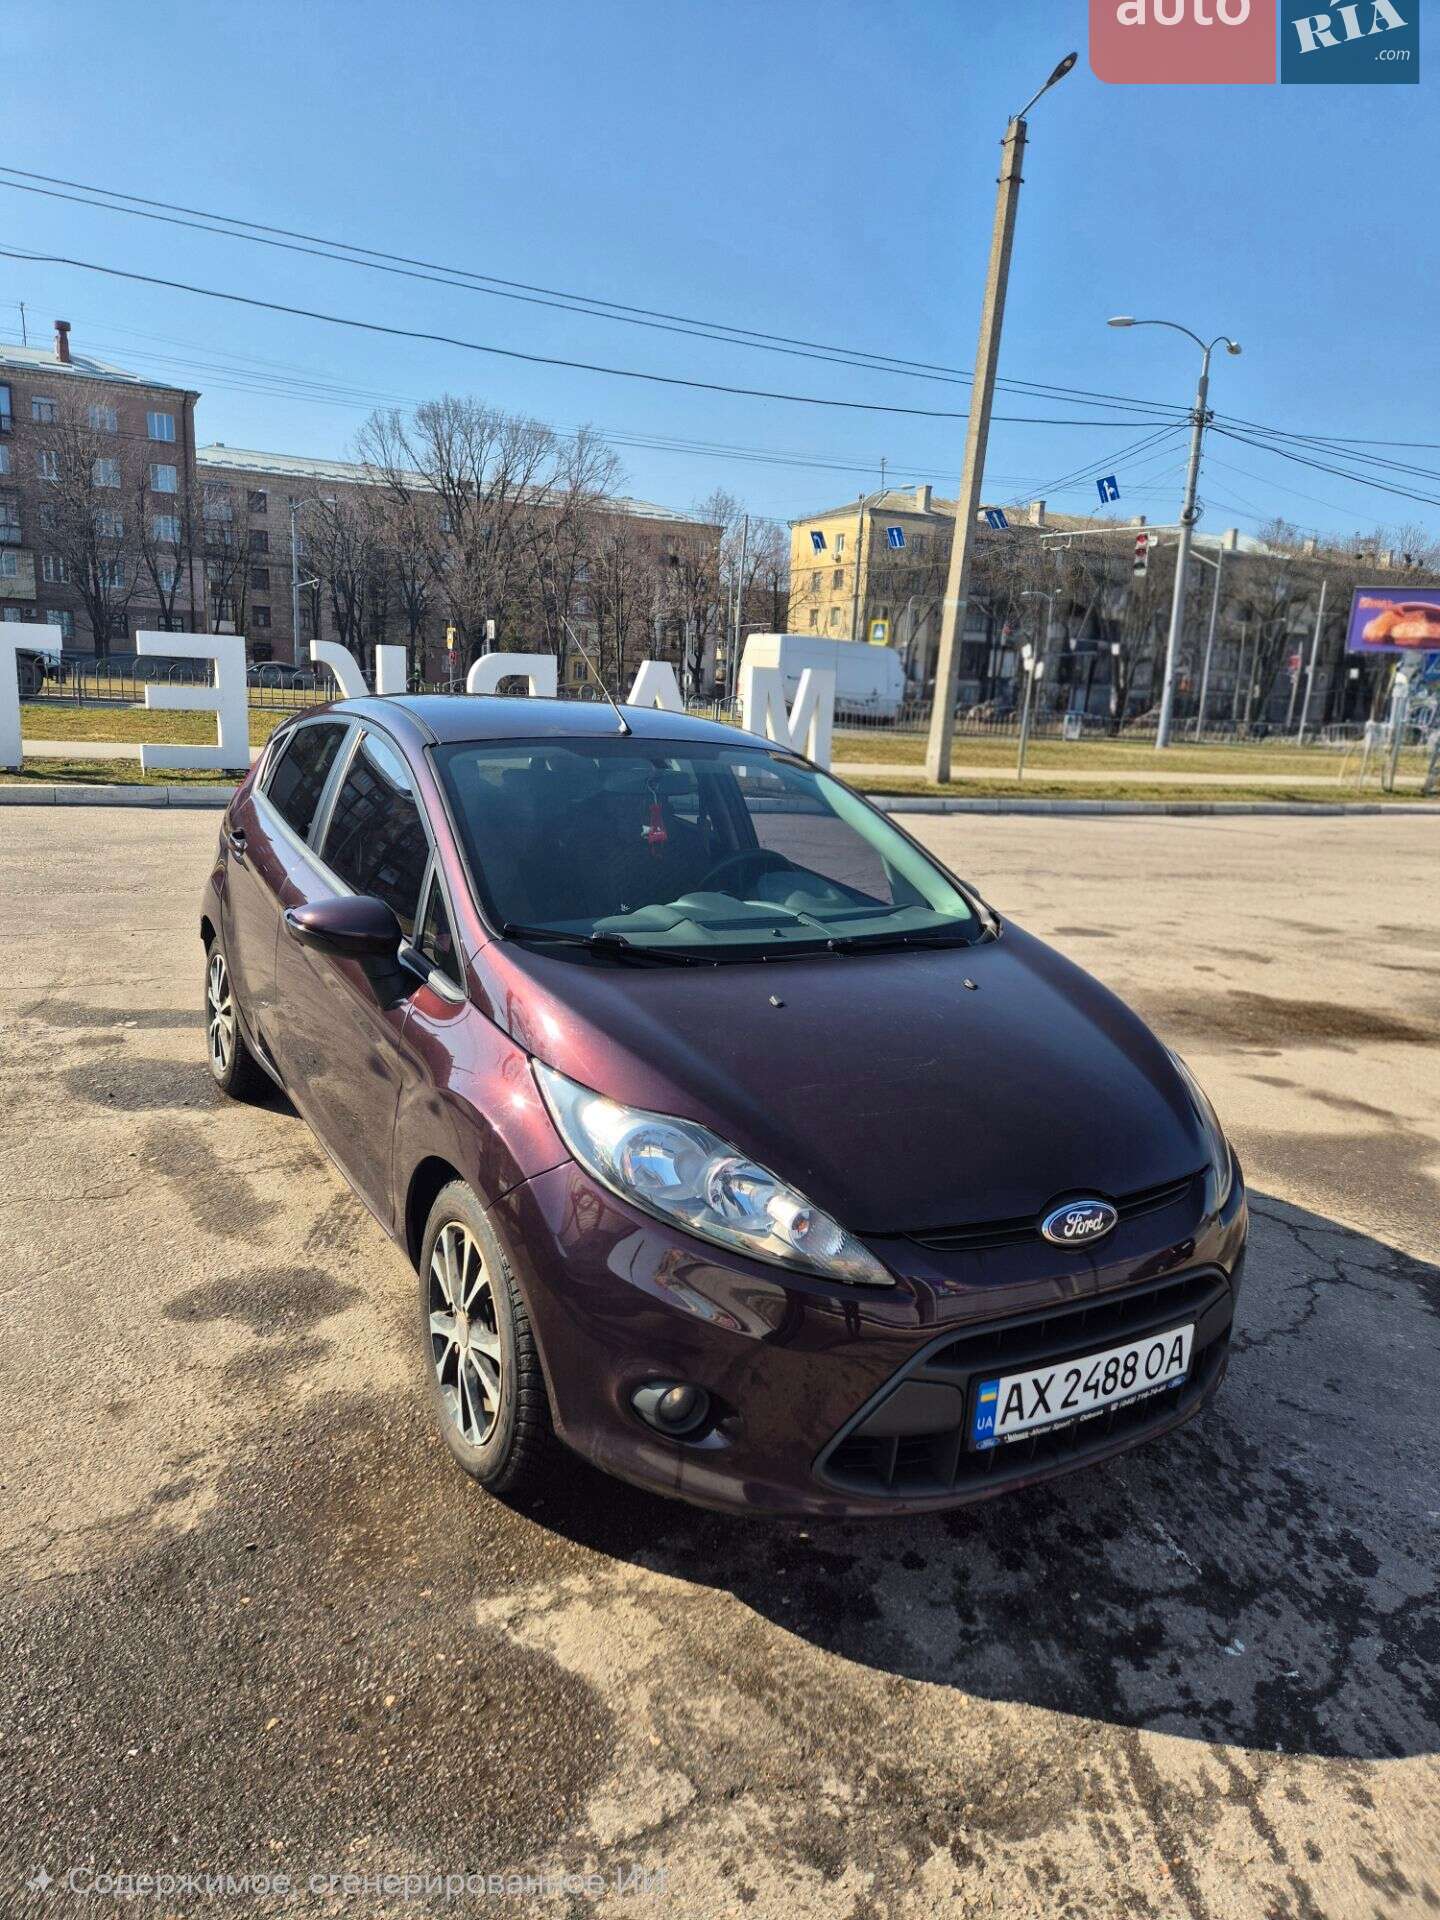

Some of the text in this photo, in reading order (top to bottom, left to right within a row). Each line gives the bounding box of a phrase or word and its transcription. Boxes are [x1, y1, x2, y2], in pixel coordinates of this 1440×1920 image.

[1063, 1209, 1104, 1237] Ford
[999, 1373, 1056, 1426] AX
[1060, 1350, 1139, 1410] 2488
[1144, 1334, 1184, 1380] OA
[976, 1415, 994, 1431] UA
